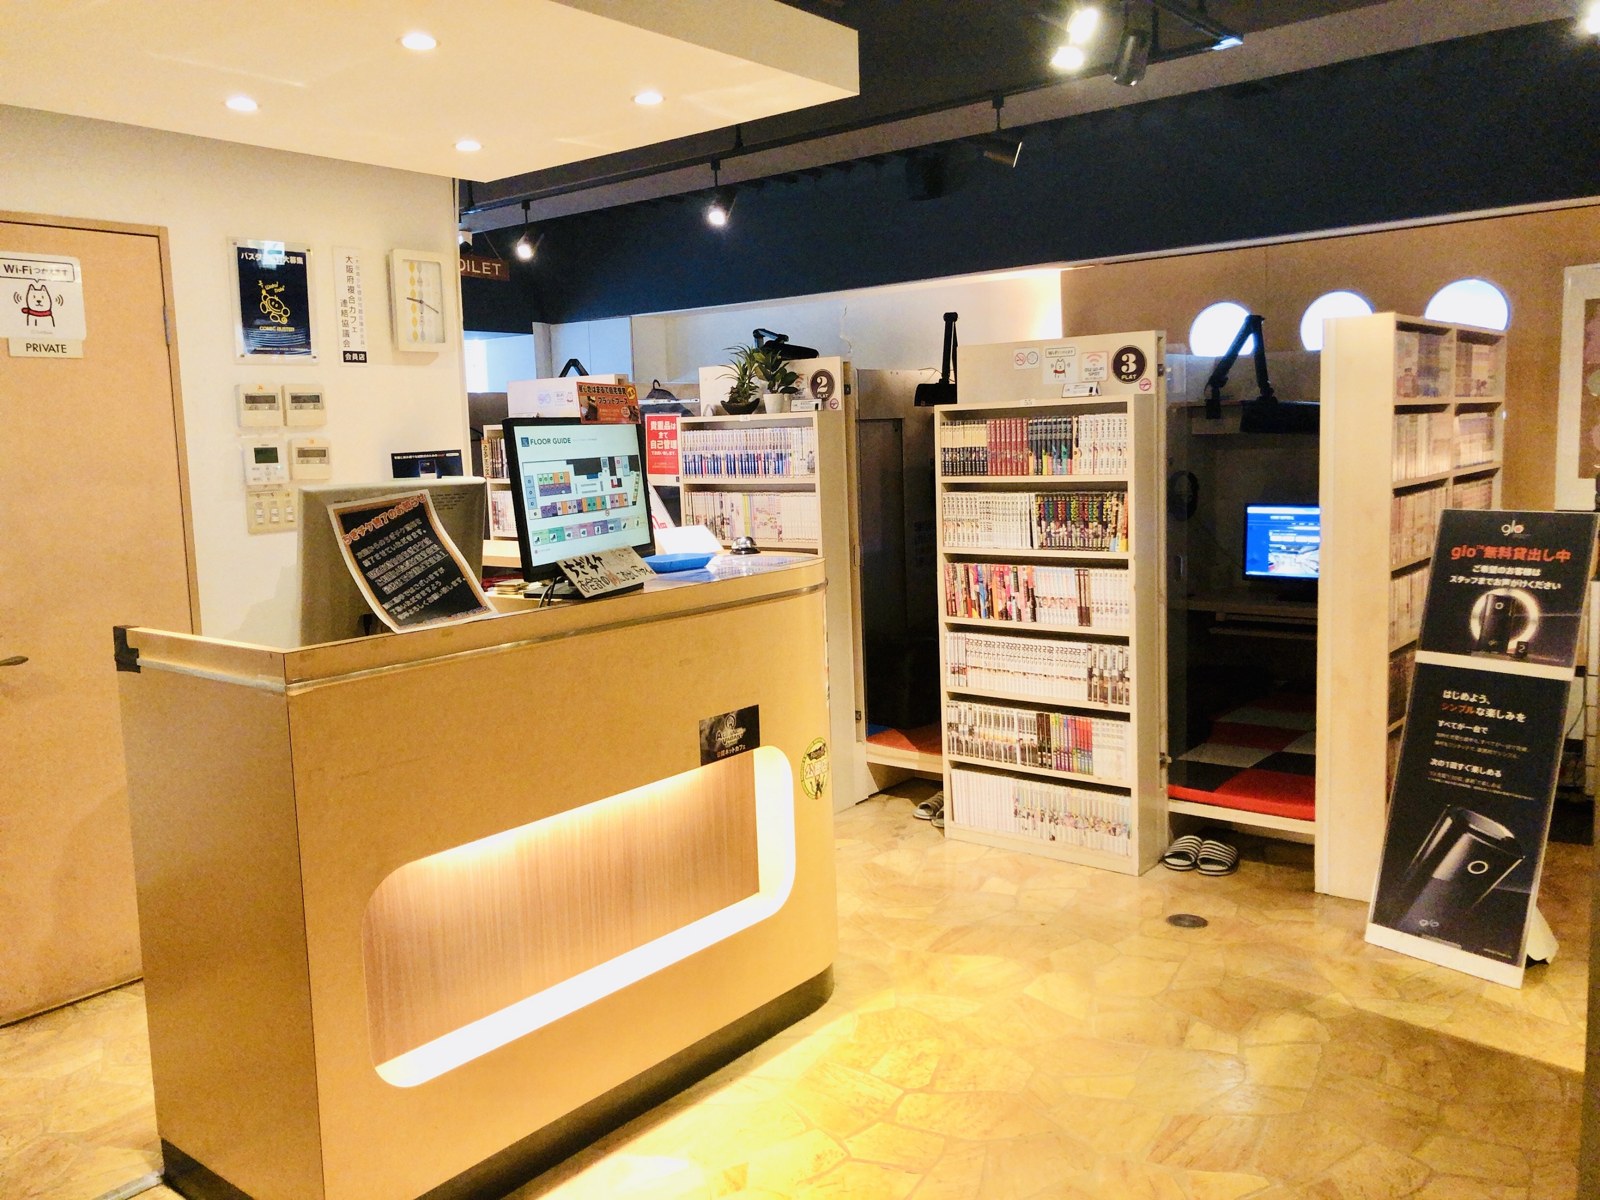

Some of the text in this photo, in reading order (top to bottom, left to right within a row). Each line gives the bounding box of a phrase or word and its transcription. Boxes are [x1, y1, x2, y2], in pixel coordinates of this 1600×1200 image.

[460, 258, 502, 276] OILET
[25, 342, 68, 354] PRIVATE
[1121, 353, 1138, 374] 3
[816, 376, 828, 393] 2
[530, 438, 552, 446] FLOOR
[552, 437, 572, 445] GUIDE
[1501, 520, 1525, 536] glo
